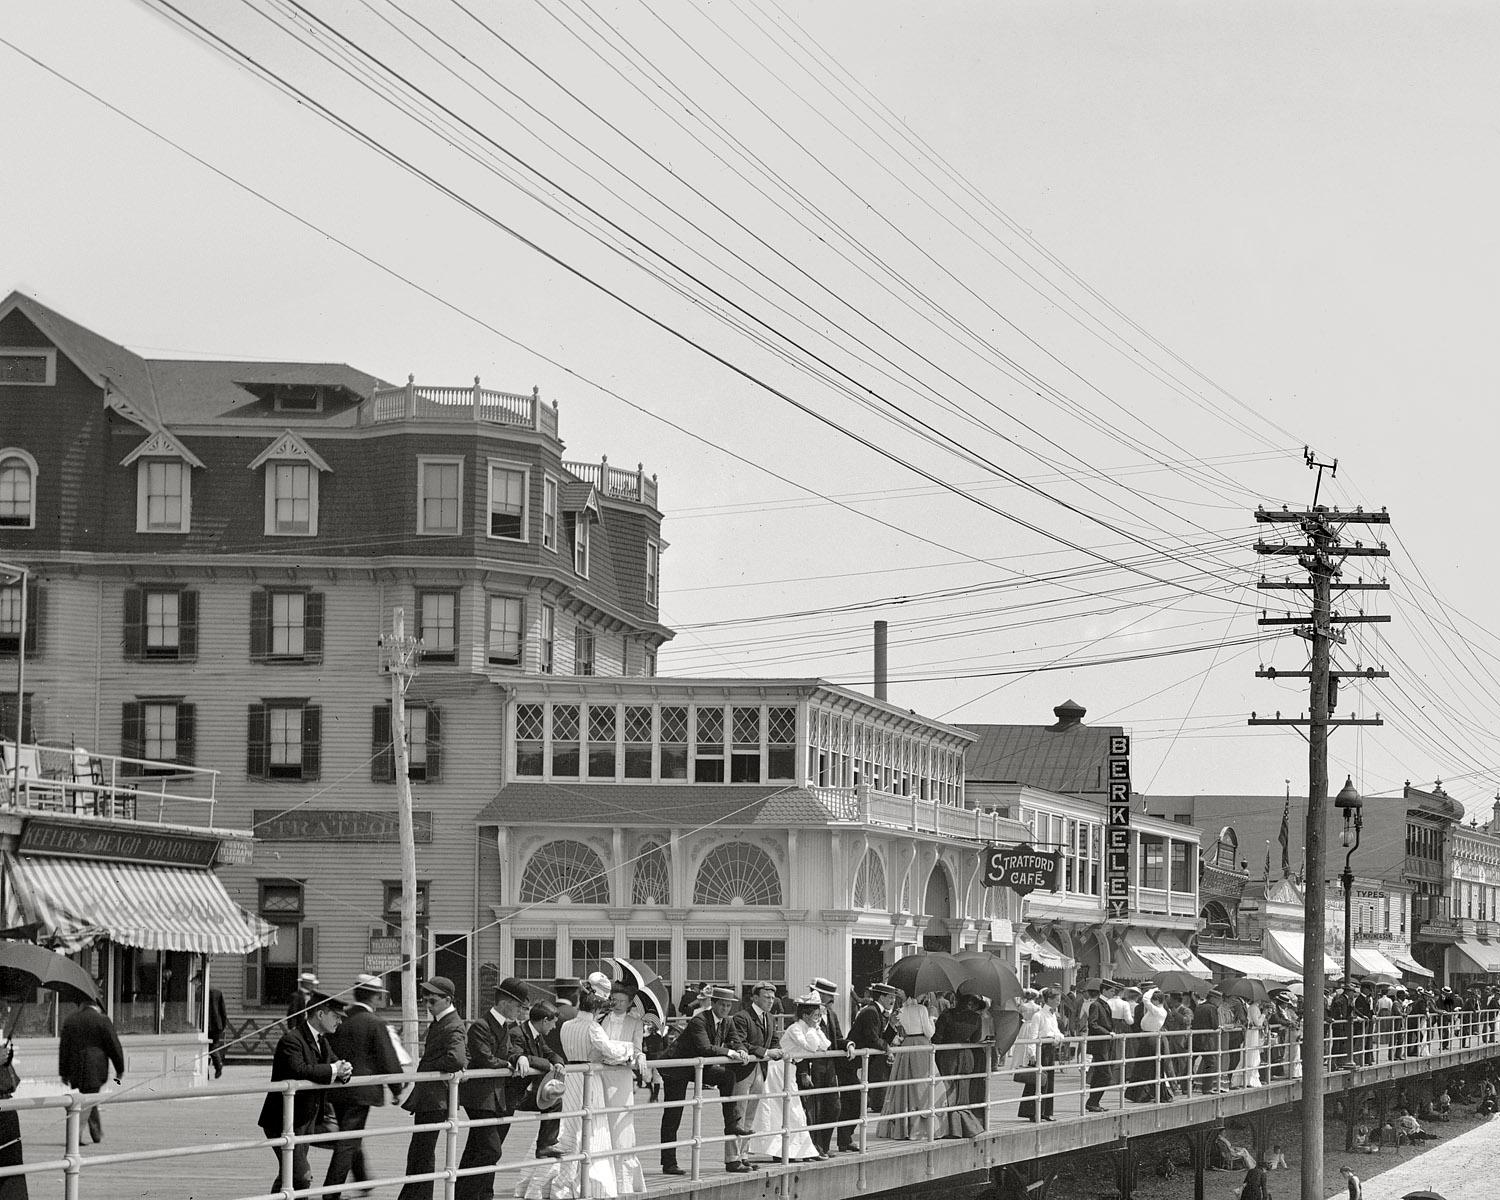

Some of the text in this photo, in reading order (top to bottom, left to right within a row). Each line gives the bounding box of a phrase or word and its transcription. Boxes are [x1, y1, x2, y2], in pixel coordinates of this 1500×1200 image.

[1110, 737, 1127, 917] BERKELEY
[22, 825, 212, 863] KEELER'S BEACH PHARMAC
[220, 848, 251, 857] TELEGRAPH
[224, 856, 246, 864] OFFICE
[988, 853, 1054, 880] STRATFORD
[1010, 870, 1045, 886] CAFÉ
[1356, 890, 1387, 898] TYPES.
